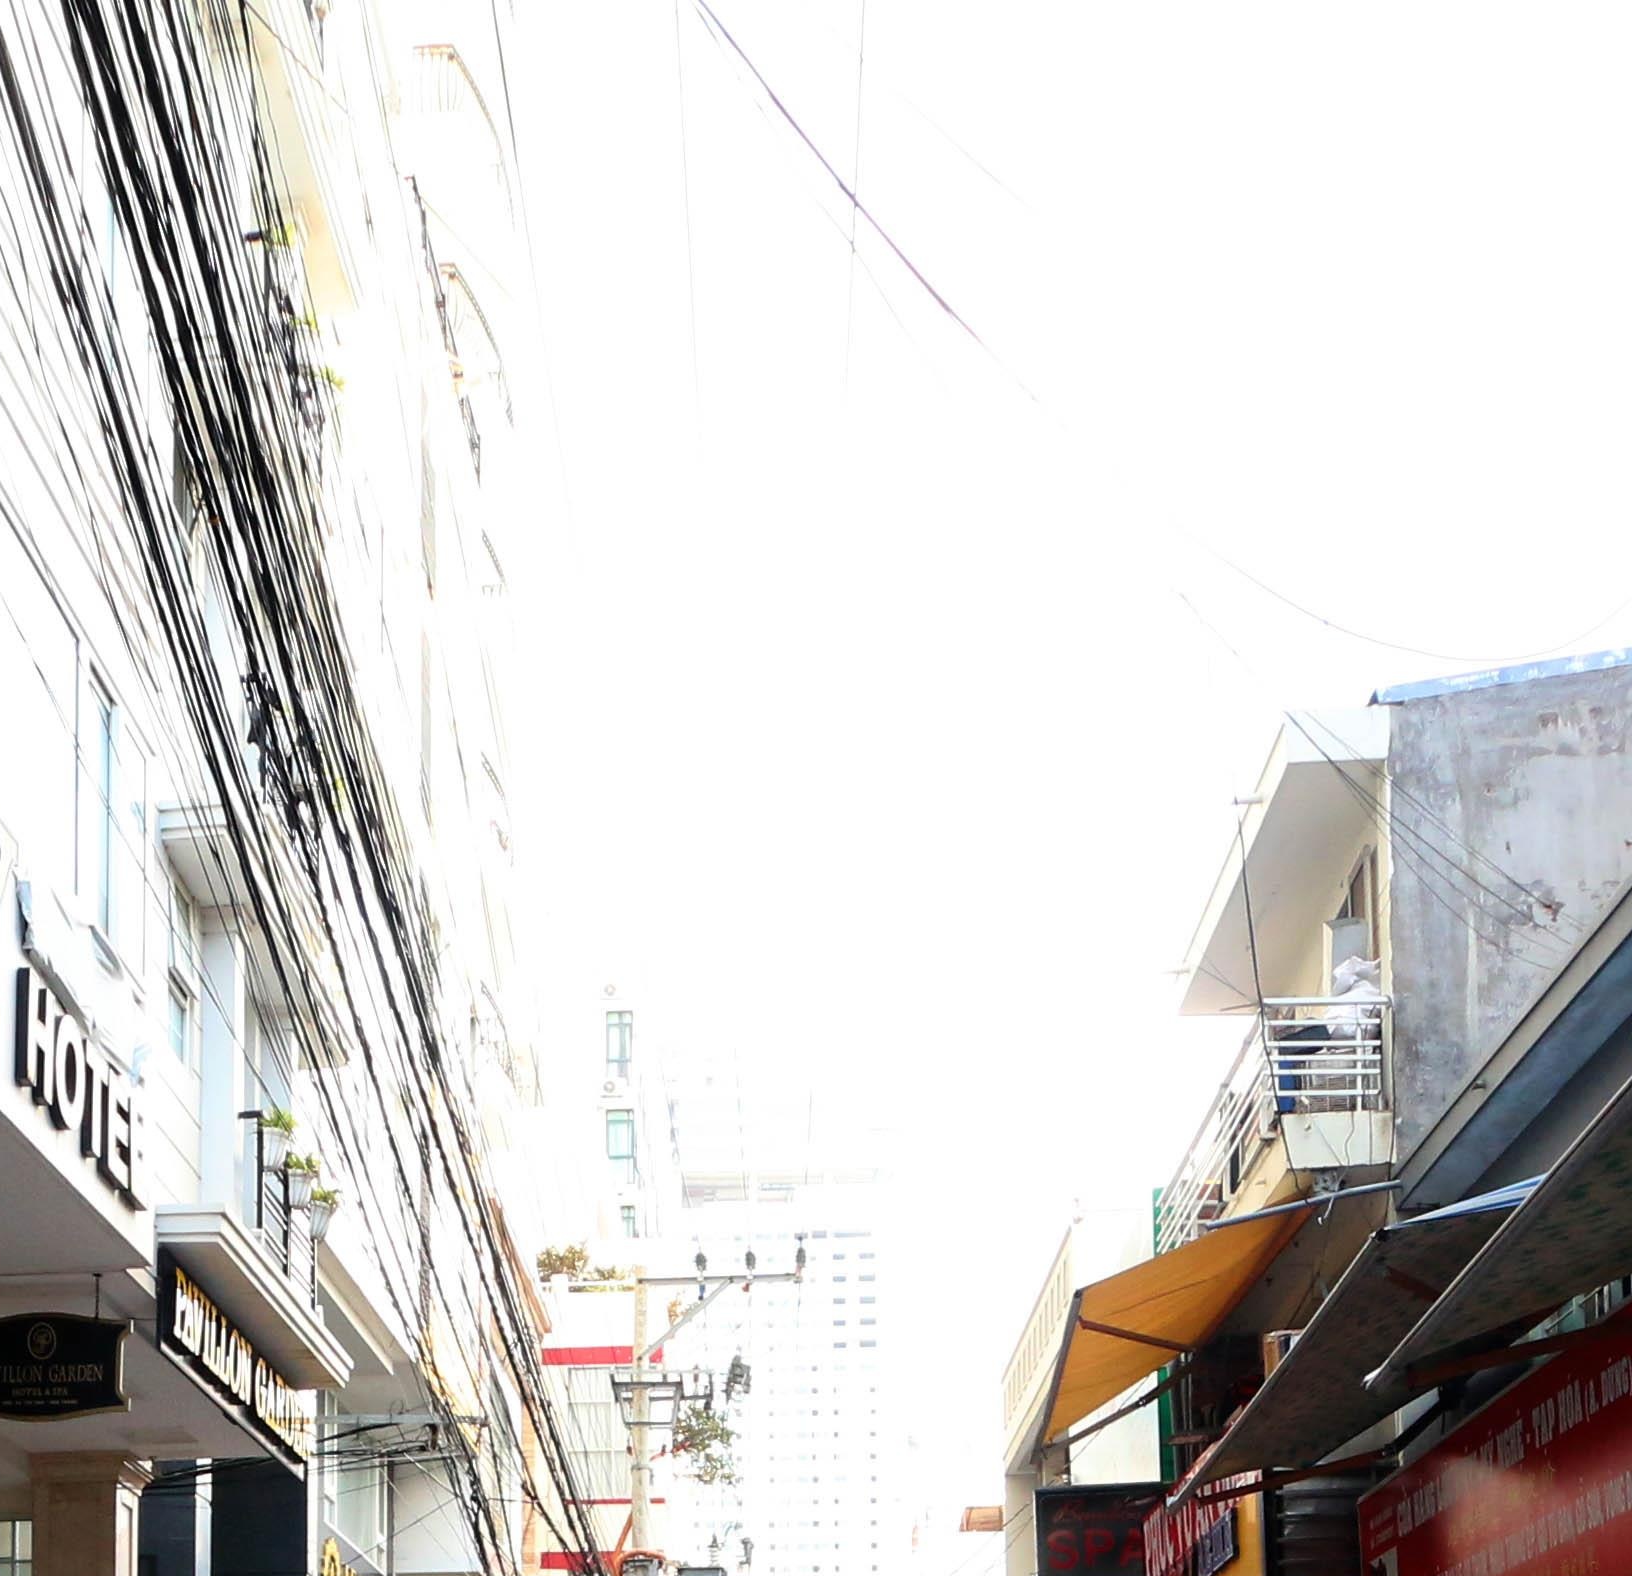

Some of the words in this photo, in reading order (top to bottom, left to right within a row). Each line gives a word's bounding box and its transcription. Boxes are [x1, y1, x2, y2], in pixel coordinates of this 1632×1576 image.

[16, 966, 148, 1212] HOTEL
[48, 1362, 105, 1383] GARDEN
[173, 1266, 253, 1406] PAVILLON
[1046, 1527, 1145, 1571] SPA
